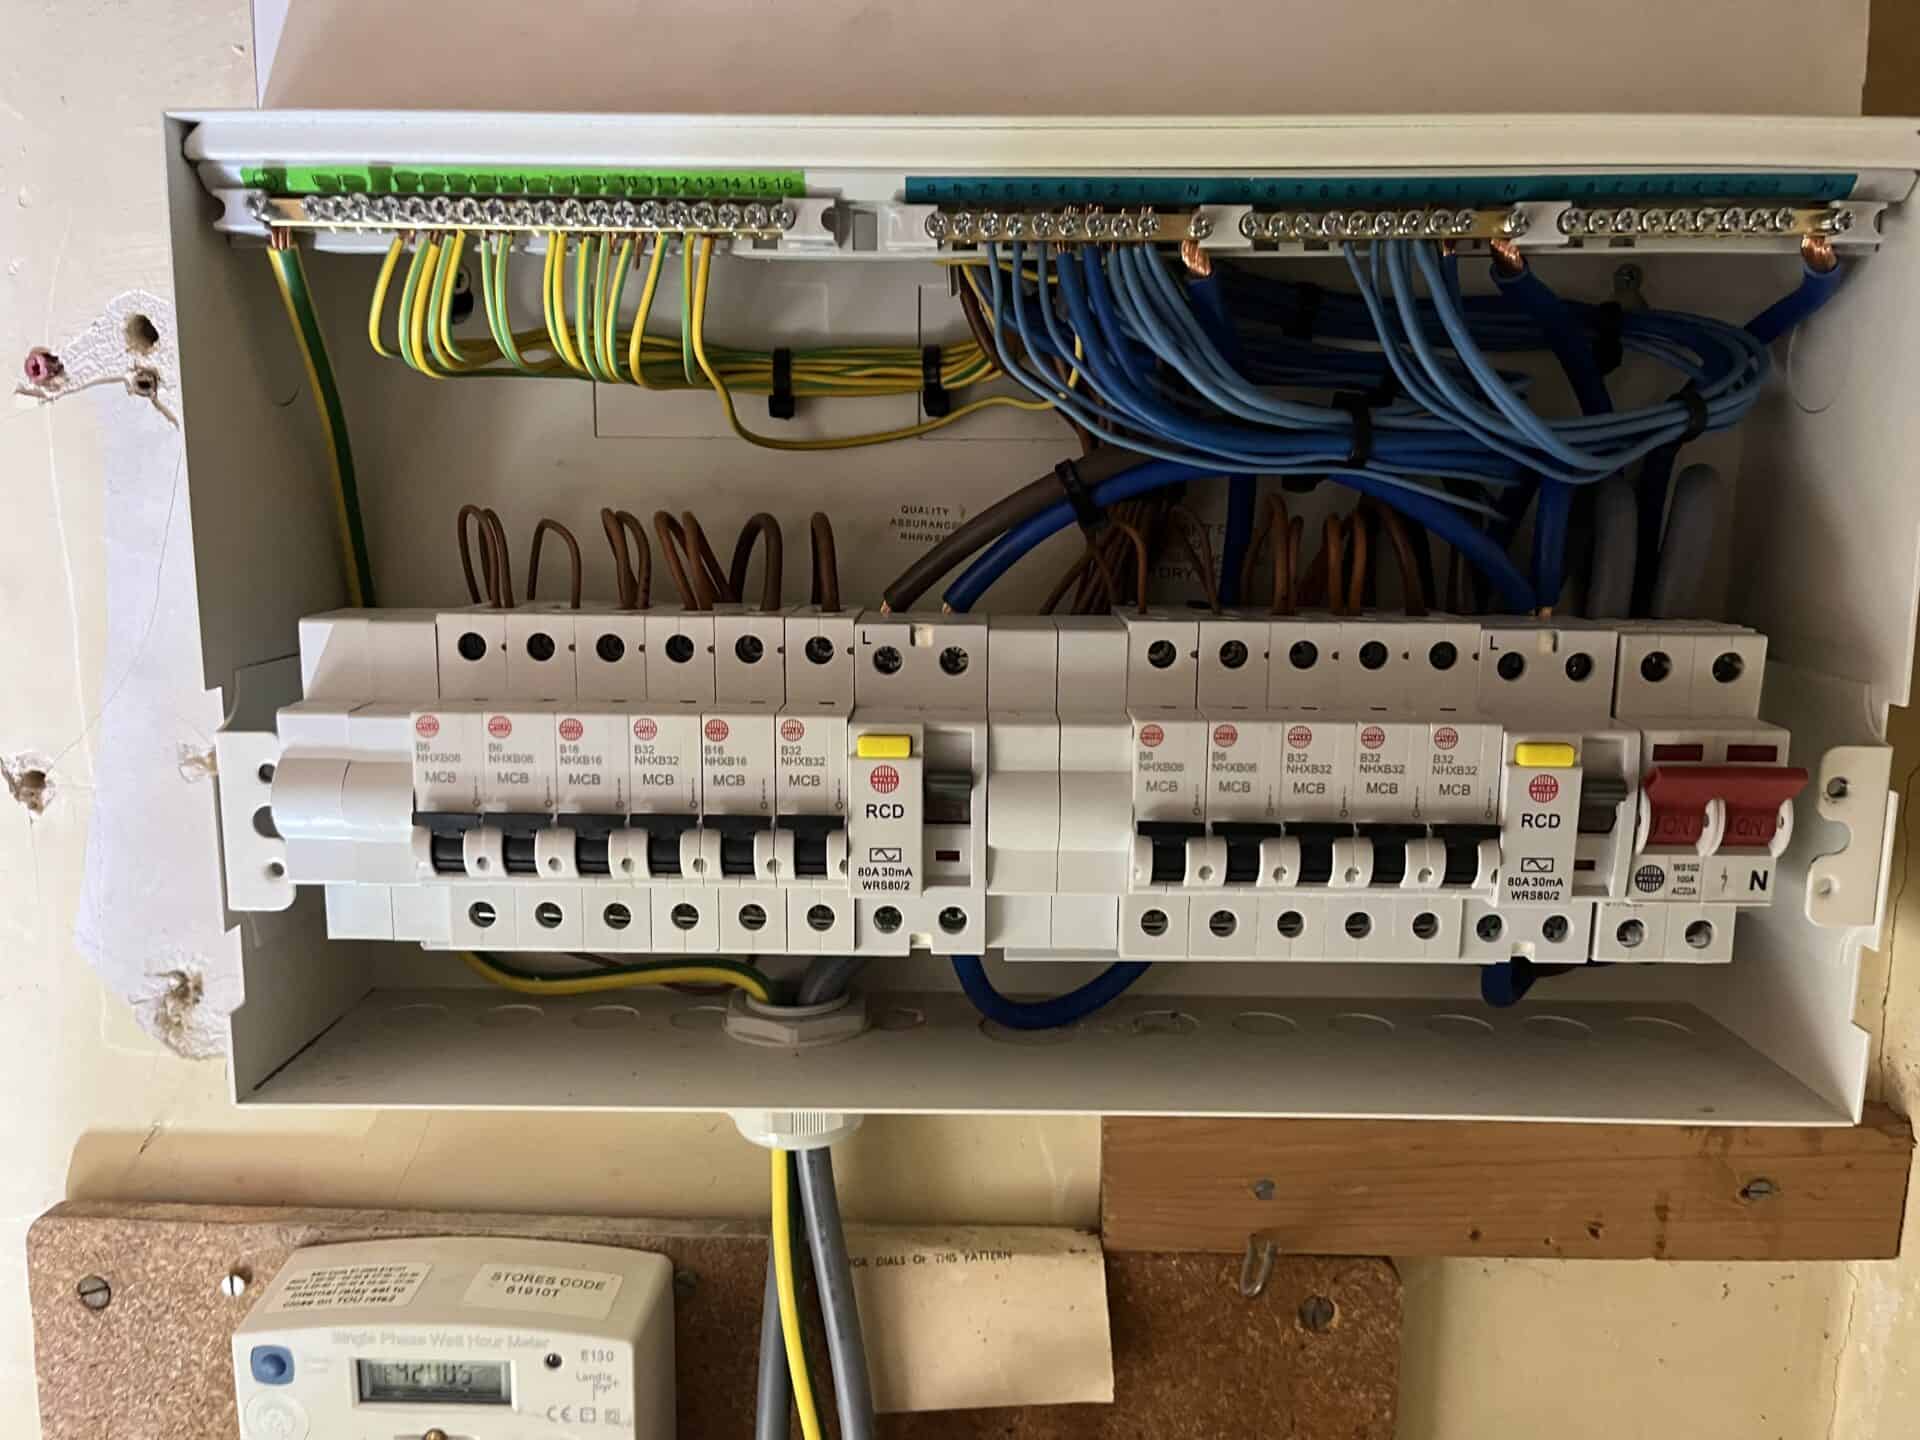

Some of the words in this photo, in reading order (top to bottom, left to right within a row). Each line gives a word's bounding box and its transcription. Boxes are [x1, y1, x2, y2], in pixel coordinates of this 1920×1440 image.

[722, 176, 741, 190] 14
[750, 176, 767, 190] 15
[776, 176, 793, 190] 16
[900, 504, 950, 516] QUALITY
[862, 631, 872, 645] L
[1489, 636, 1499, 650] L
[634, 744, 655, 754] B32
[780, 745, 802, 755] B32
[634, 756, 679, 766] NHXB32
[780, 757, 826, 767] NHXB32
[1286, 753, 1308, 763] B32
[1359, 753, 1381, 763] B32
[1432, 754, 1454, 764] B32
[1285, 764, 1333, 775] NHXB32
[1359, 764, 1406, 775] NHXB32
[1431, 765, 1478, 776] NHXB32
[424, 771, 457, 784] MCB
[497, 772, 529, 784] MCB
[568, 773, 601, 785] MCB
[642, 773, 675, 786] MCB
[712, 774, 746, 787] MCB
[788, 774, 821, 787] MCB
[1145, 780, 1179, 793] MCB
[1218, 780, 1251, 793] MCB
[1293, 782, 1326, 795] MCB
[1366, 782, 1399, 795] MCB
[1439, 784, 1471, 796] MCB
[865, 803, 905, 819] RCD
[1521, 812, 1561, 828] RCD
[857, 867, 880, 877] 80A
[881, 867, 913, 877] 30mA
[862, 880, 911, 890] WRS80/2
[1507, 877, 1530, 887] 80A
[1531, 877, 1564, 888] 30mA
[1749, 869, 1769, 892] N
[1511, 890, 1560, 901] WRS80/2
[876, 1255, 906, 1266] DIALS
[490, 1271, 557, 1286] STORES
[560, 1277, 607, 1291] CODE
[467, 1333, 504, 1348] Hour
[507, 1335, 551, 1349] Meter
